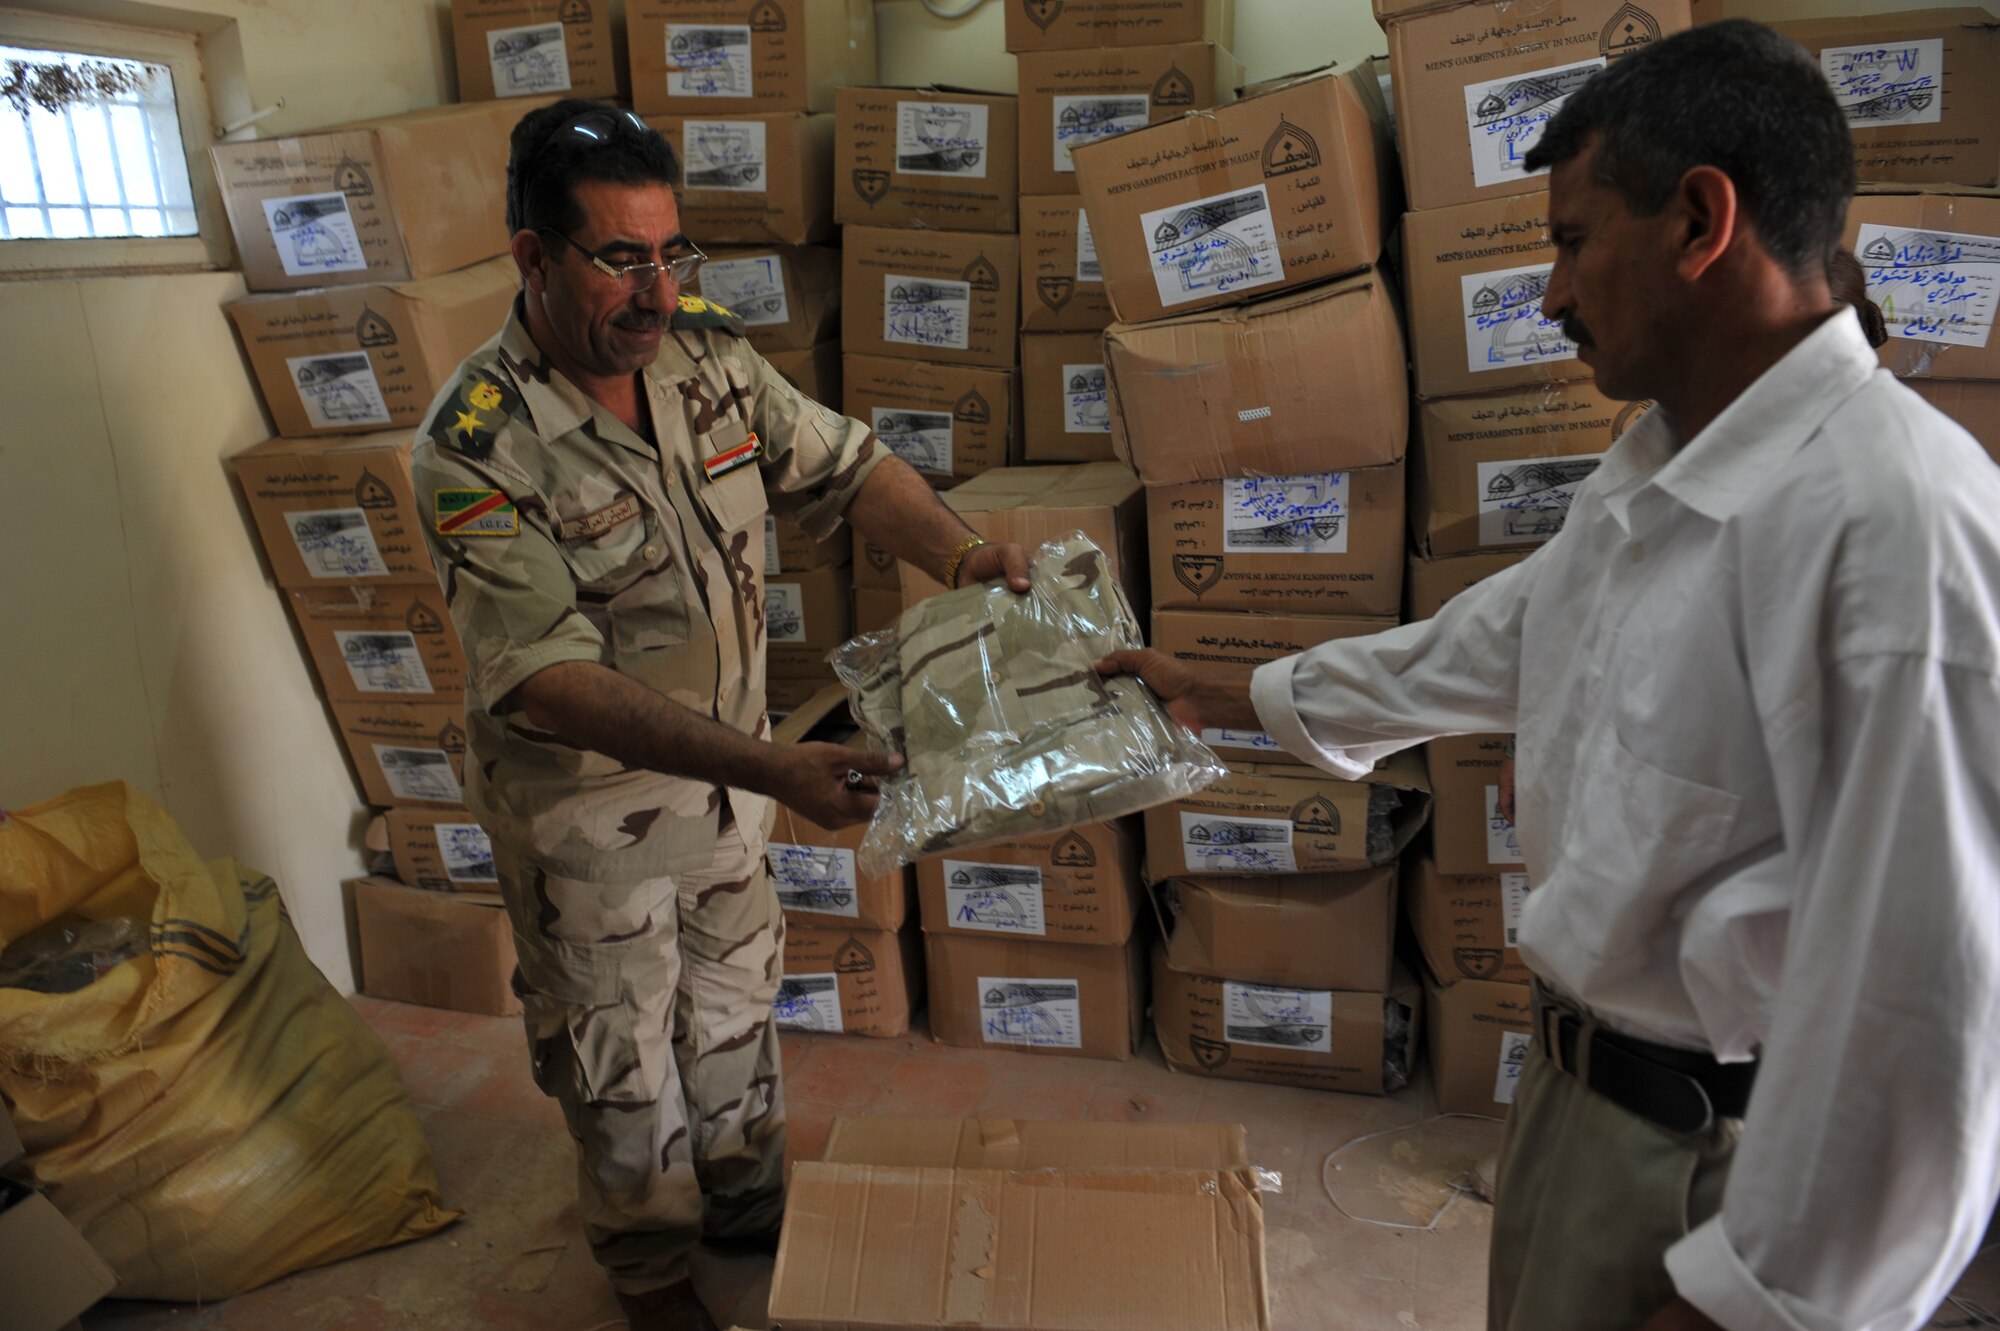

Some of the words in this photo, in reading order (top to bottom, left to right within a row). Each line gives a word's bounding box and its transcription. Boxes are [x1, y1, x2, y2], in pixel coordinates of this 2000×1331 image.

[1557, 15, 1577, 26] معمل
[1450, 33, 1475, 45] النجف
[1477, 29, 1489, 45] في
[1425, 59, 1453, 71] MEN'S
[1455, 51, 1505, 67] GARMENTS
[1506, 42, 1550, 57] FACTORY
[1552, 39, 1563, 48] IN
[1563, 32, 1598, 48] NAGAF
[1220, 137, 1239, 148] معمل
[1126, 158, 1148, 170] النجف
[1148, 153, 1162, 168] في
[1107, 184, 1133, 195] MEN'S
[1133, 171, 1177, 190] GARMENTS
[1177, 161, 1217, 181] FACTORY
[1219, 160, 1231, 169] IN
[1231, 150, 1260, 166] NAGAF
[1295, 175, 1321, 190] الكمية
[1460, 228, 1486, 240] النجف
[1487, 225, 1500, 240] في
[1435, 252, 1464, 263] MEN'S
[1465, 245, 1514, 259] GARMENTS
[1571, 402, 1592, 411] معمل
[1471, 410, 1495, 421] النجف
[1497, 409, 1508, 422] في
[1447, 432, 1475, 442] MEN'S
[1476, 427, 1524, 440] GARMENTS
[1525, 423, 1566, 435] FACTORY
[1568, 422, 1579, 430] IN
[1579, 418, 1612, 429] NAGAF
[1223, 572, 1250, 580] NAGAF
[1250, 573, 1261, 581] IN
[1264, 573, 1301, 581] FACTORY
[1303, 573, 1347, 581] GARMENTS
[1348, 573, 1374, 581] MEN'S
